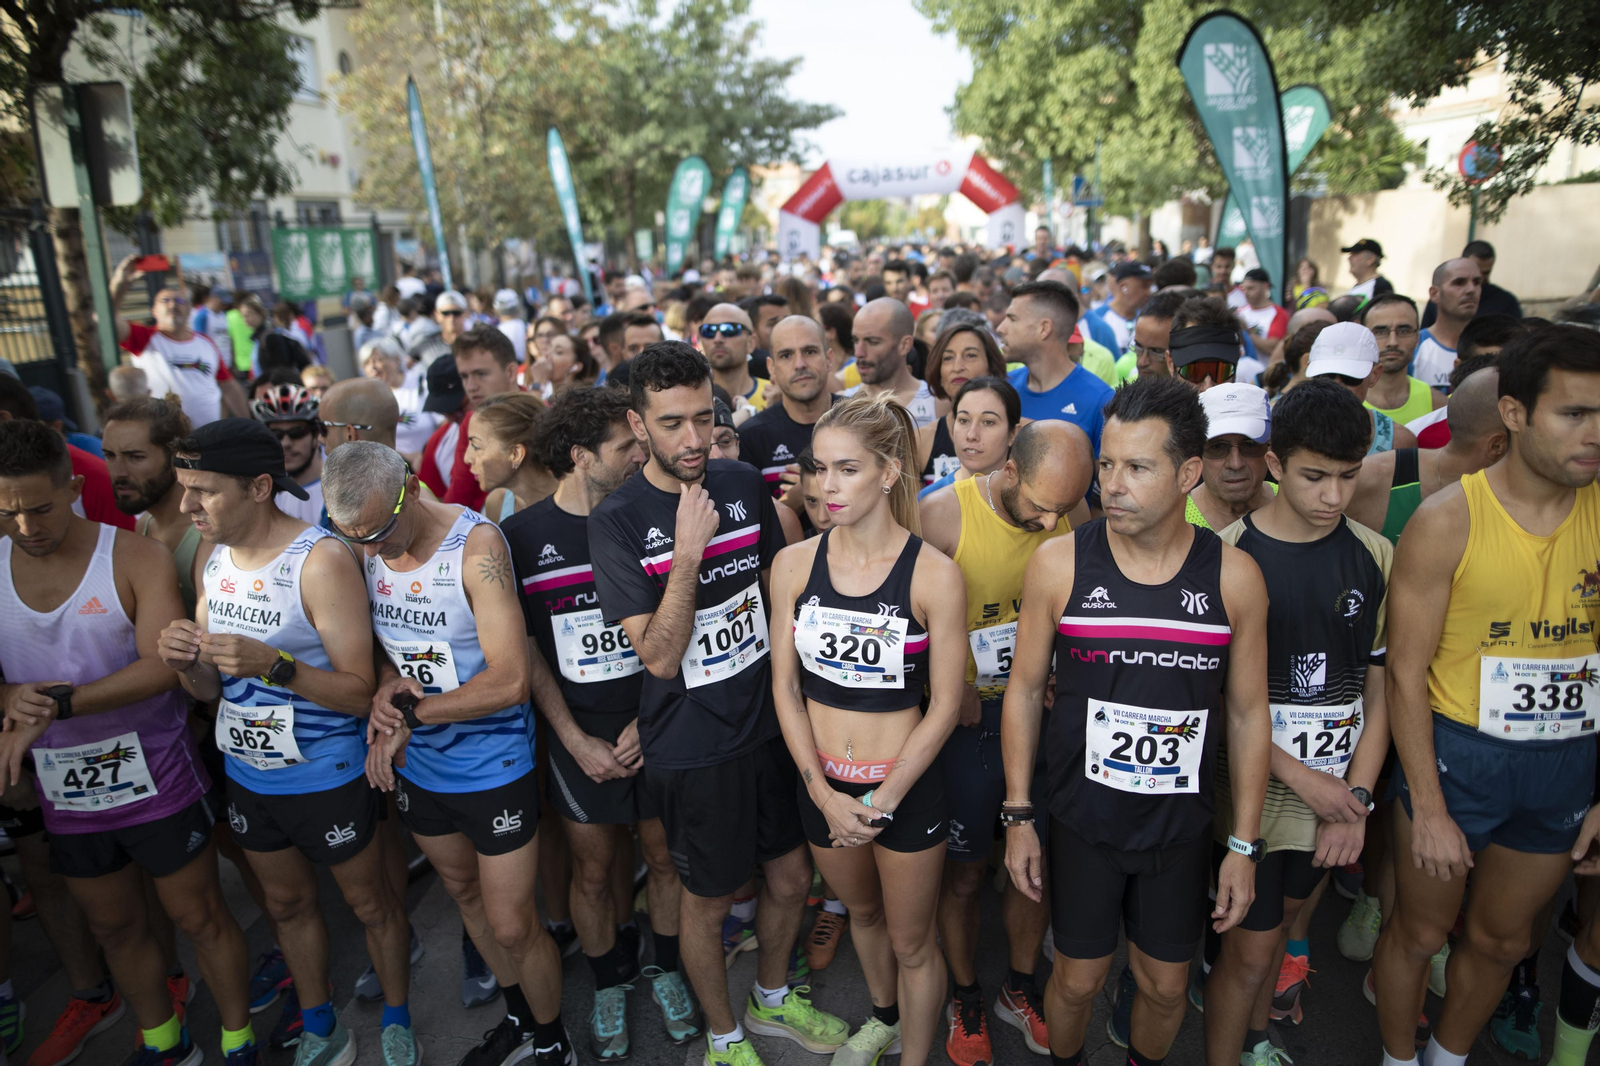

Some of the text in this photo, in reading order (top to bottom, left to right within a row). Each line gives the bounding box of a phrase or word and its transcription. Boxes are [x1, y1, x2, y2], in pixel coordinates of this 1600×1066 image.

[847, 165, 930, 186] cajasur
[646, 537, 674, 550] austral
[538, 556, 565, 566] austral
[208, 599, 282, 626] MARACENA
[370, 600, 447, 626] MARACENA
[704, 608, 725, 620] CARRERA
[725, 600, 738, 612] MARCHA
[728, 600, 752, 619] ASPACE
[1082, 600, 1118, 609] austral
[581, 614, 601, 622] CARRERA
[829, 612, 850, 622] CARRERA
[851, 615, 872, 624] MARCHA
[235, 623, 268, 634] ATLETISMO
[401, 624, 435, 635] ATLETISMO
[698, 612, 754, 656] 1001
[852, 626, 892, 637] ASPACE
[996, 627, 1016, 636] CARRERA
[582, 628, 632, 656] 986
[819, 632, 881, 666] 320
[996, 647, 1013, 672] 5
[1070, 648, 1220, 670] runrundata
[1553, 671, 1590, 680] ASPACE
[1512, 683, 1583, 712] 338
[1121, 710, 1147, 721] CARRERA
[229, 727, 275, 750] 962
[1292, 728, 1351, 758] 124
[82, 748, 104, 756] MARCHA
[88, 750, 126, 763] ASPACE
[1109, 732, 1180, 766] 203
[63, 760, 121, 790] 427
[825, 760, 886, 779] NIKE
